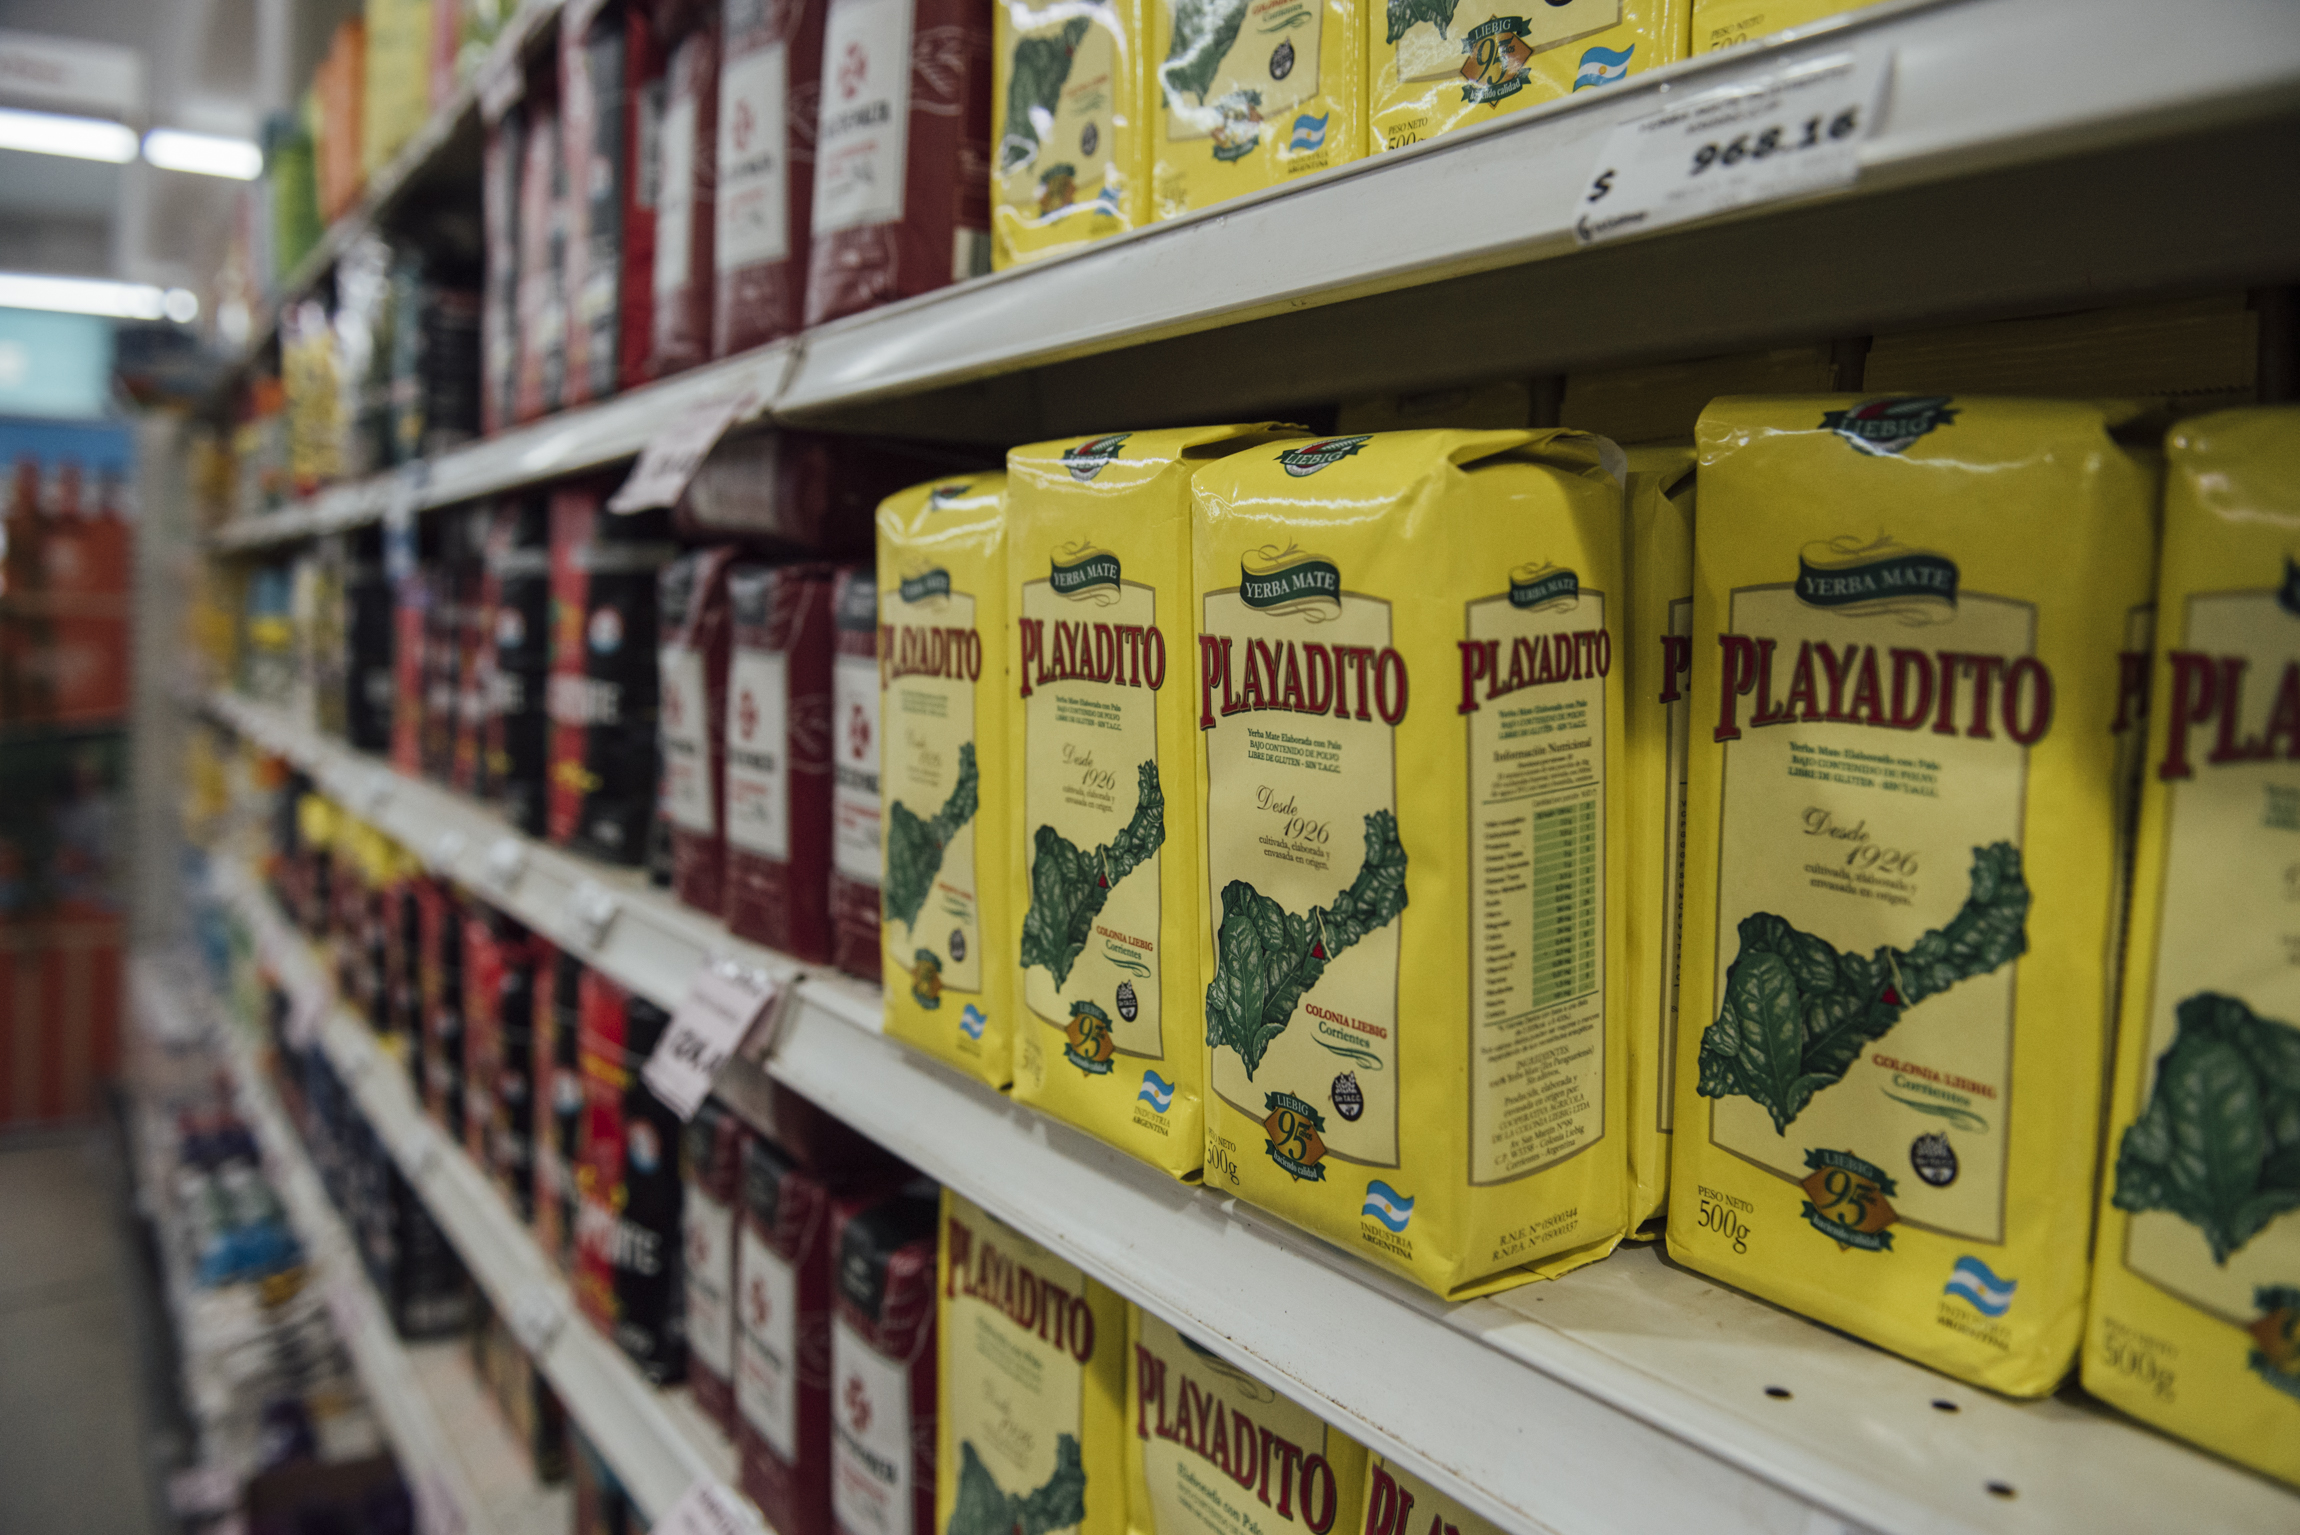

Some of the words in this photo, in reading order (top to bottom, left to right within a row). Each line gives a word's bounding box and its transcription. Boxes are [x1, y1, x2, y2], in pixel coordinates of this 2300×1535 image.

[1474, 18, 1512, 40] LIEBIG
[1496, 78, 1521, 96] calidad
[1388, 121, 1407, 136] PESO
[1408, 117, 1428, 132] NETO
[1282, 450, 1344, 466] LIEBIG
[1053, 570, 1086, 587] YERBA
[1087, 563, 1118, 580] MATE
[1245, 579, 1290, 599] YERBA
[1292, 571, 1336, 591] MATE
[1803, 574, 1878, 598] YERBA
[1880, 565, 1951, 592] MATE
[1018, 617, 1166, 699] PLAYADITO
[1457, 629, 1611, 714] PLAYADITO
[1198, 632, 1409, 731] PLAYADITO
[1713, 632, 2056, 747] PLAYADITO
[1247, 727, 1265, 740] Yerba
[1265, 730, 1281, 741] Mate
[1281, 733, 1313, 746] Elaborada
[1062, 742, 1094, 768] Desde
[1248, 750, 1265, 761] LIBRE
[1265, 753, 1275, 763] DE
[1274, 754, 1301, 767] GLUTEN
[1305, 760, 1317, 770] SIN
[1249, 739, 1265, 751] BAJO
[1264, 742, 1305, 756] CONTENIDO
[1305, 749, 1315, 758] DE
[1316, 750, 1340, 763] POLVO
[1082, 768, 1116, 791] 1926
[1256, 784, 1298, 816] Desde
[1283, 817, 1332, 844] 1926
[1802, 805, 1870, 842] Desde
[1258, 835, 1290, 851] cultivada,
[1263, 848, 1295, 862] envasada
[1295, 855, 1304, 865] en
[1846, 844, 1920, 878] 1926
[1096, 925, 1128, 946] COLONIA
[1128, 935, 1154, 952] LIEBIG
[1105, 939, 1142, 961] Corrientes
[1305, 1003, 1350, 1029] COLONIA
[1351, 1018, 1388, 1040] LIEBIG
[1318, 1020, 1371, 1049] Corrientes
[1078, 1015, 1105, 1059] 95
[1872, 1053, 1940, 1083] COLONIA
[1133, 1105, 1171, 1129] INDUSTRIA
[1276, 1094, 1309, 1117] LIEBIG
[1132, 1115, 1169, 1137] ARGENTINA
[1276, 1110, 1312, 1161] 95
[1218, 1135, 1237, 1153] NETO
[1273, 1149, 1298, 1173] haciendo
[1297, 1165, 1318, 1180] calidad
[1697, 1184, 1724, 1203] PESO
[1725, 1193, 1755, 1214] NETO
[1820, 1169, 1877, 1228] 95
[1360, 1221, 1413, 1251] INDUSTRIA
[1697, 1199, 1752, 1254] 500g
[1361, 1232, 1413, 1261] ARGENTINA
[1135, 1340, 1338, 1535] PLAYADITO
